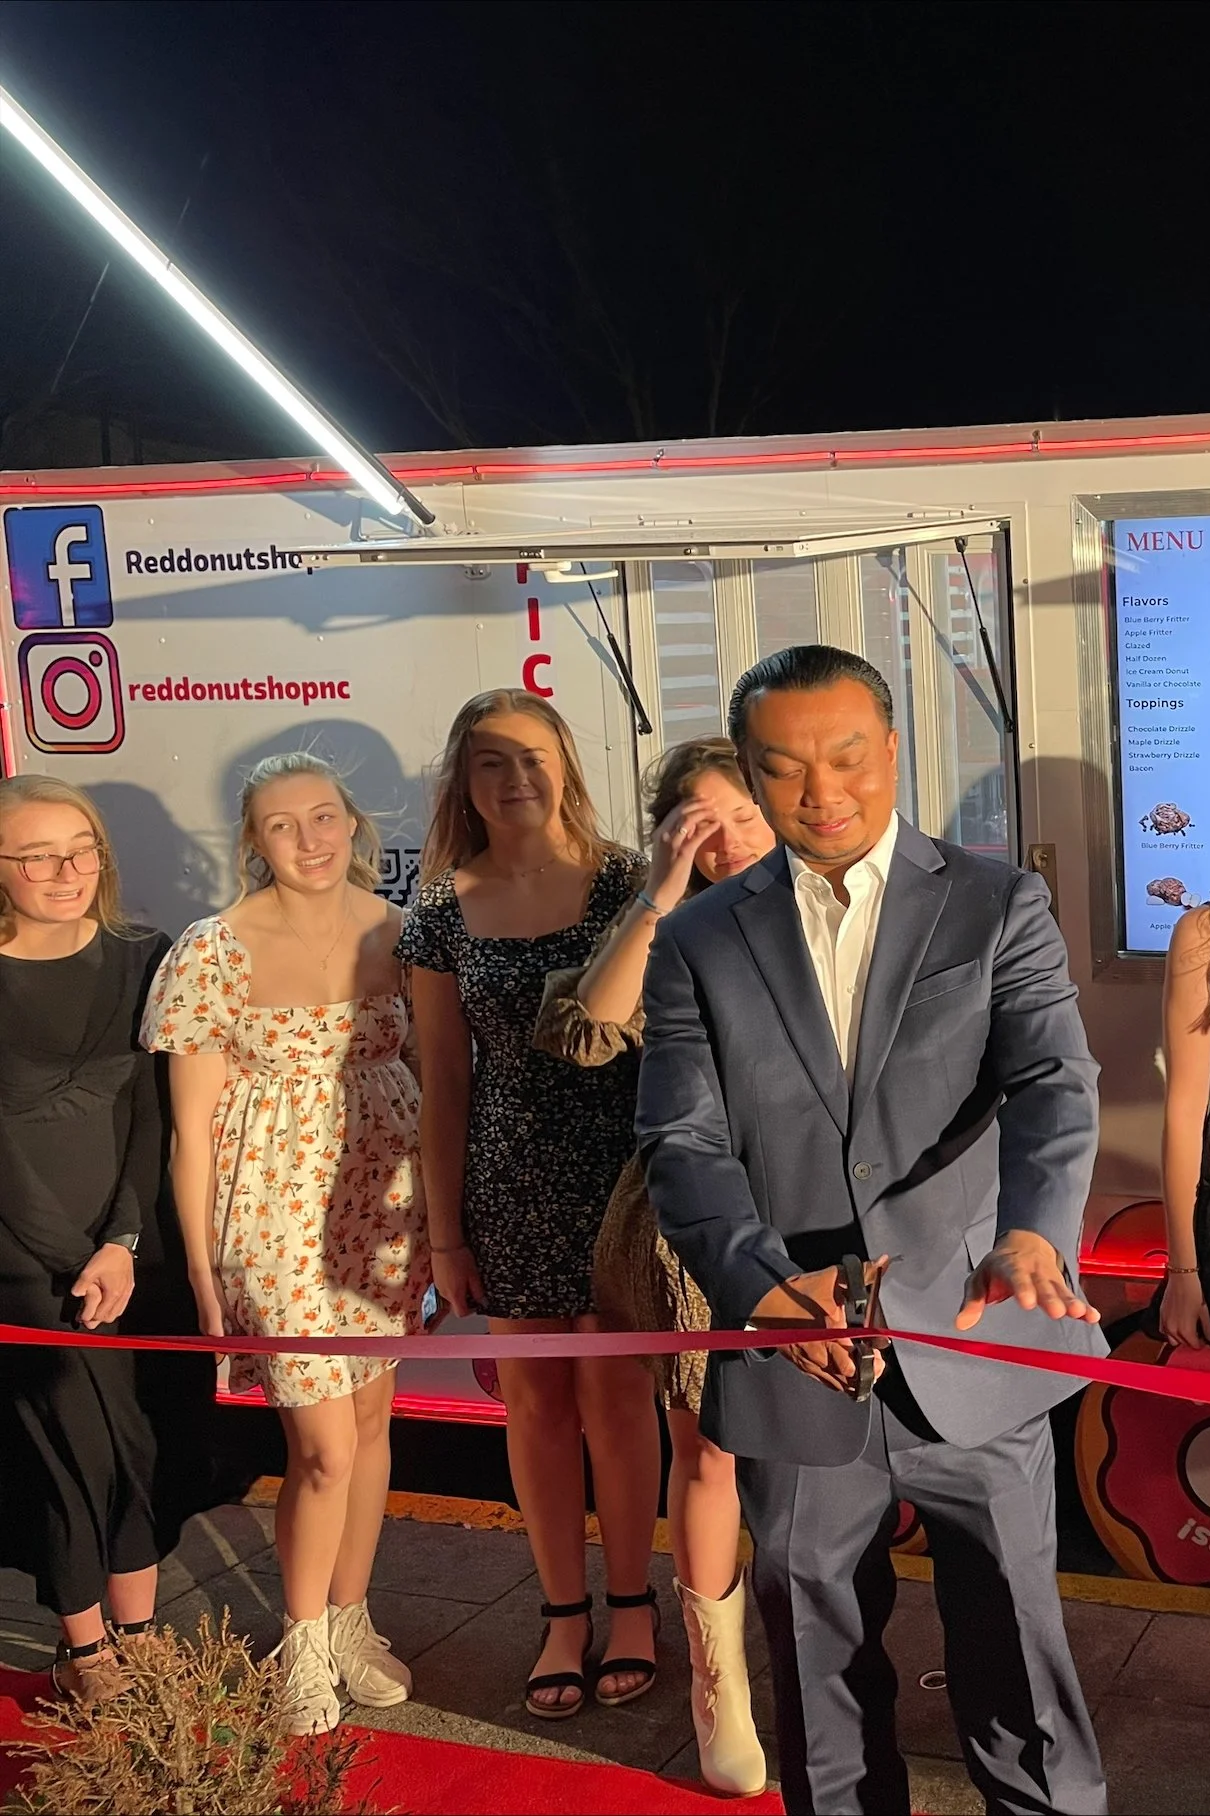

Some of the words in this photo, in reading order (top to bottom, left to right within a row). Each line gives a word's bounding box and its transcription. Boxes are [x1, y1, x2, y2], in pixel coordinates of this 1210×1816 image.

[1127, 530, 1204, 551] MENU
[125, 545, 313, 575] Reddonutsho
[1122, 596, 1169, 607] Flavors
[1124, 616, 1142, 624] Blue
[1143, 616, 1165, 625] Berry
[1166, 615, 1190, 623] Fritter
[1124, 629, 1147, 637] Apple
[128, 676, 351, 705] reddonutshopnc
[1125, 698, 1184, 710] Toppings
[1127, 725, 1167, 733] Chocolate
[1127, 739, 1152, 747] Maple
[1128, 751, 1172, 760] Strawberry
[1173, 751, 1201, 759] Drizzle
[1159, 842, 1180, 850] Berry
[1181, 842, 1204, 850] Fritter
[1149, 922, 1171, 930] Apple
